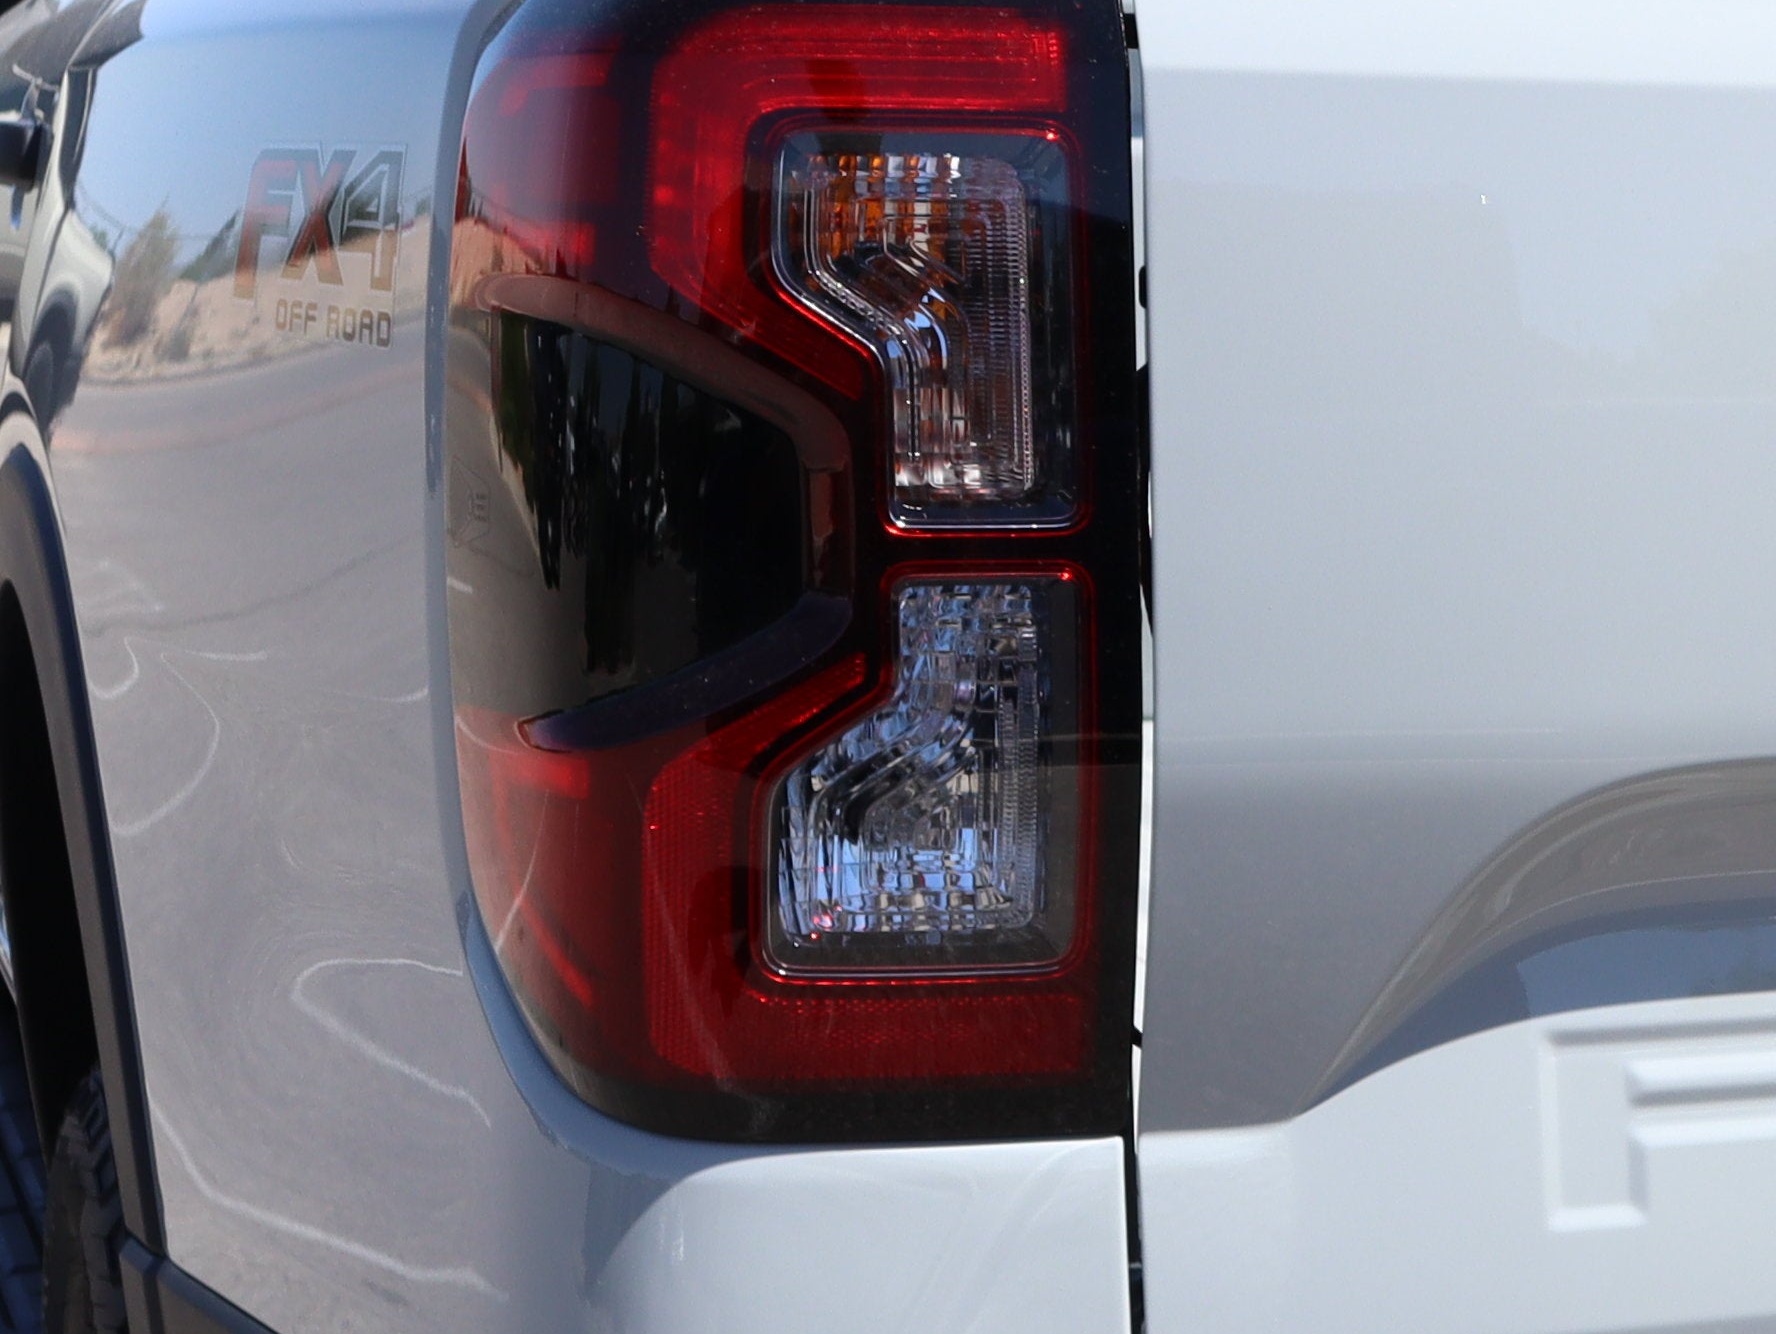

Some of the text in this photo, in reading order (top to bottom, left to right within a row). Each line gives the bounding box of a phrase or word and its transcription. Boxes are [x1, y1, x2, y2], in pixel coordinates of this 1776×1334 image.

[233, 144, 405, 301] FX4
[275, 298, 393, 348] OFF ROAD
